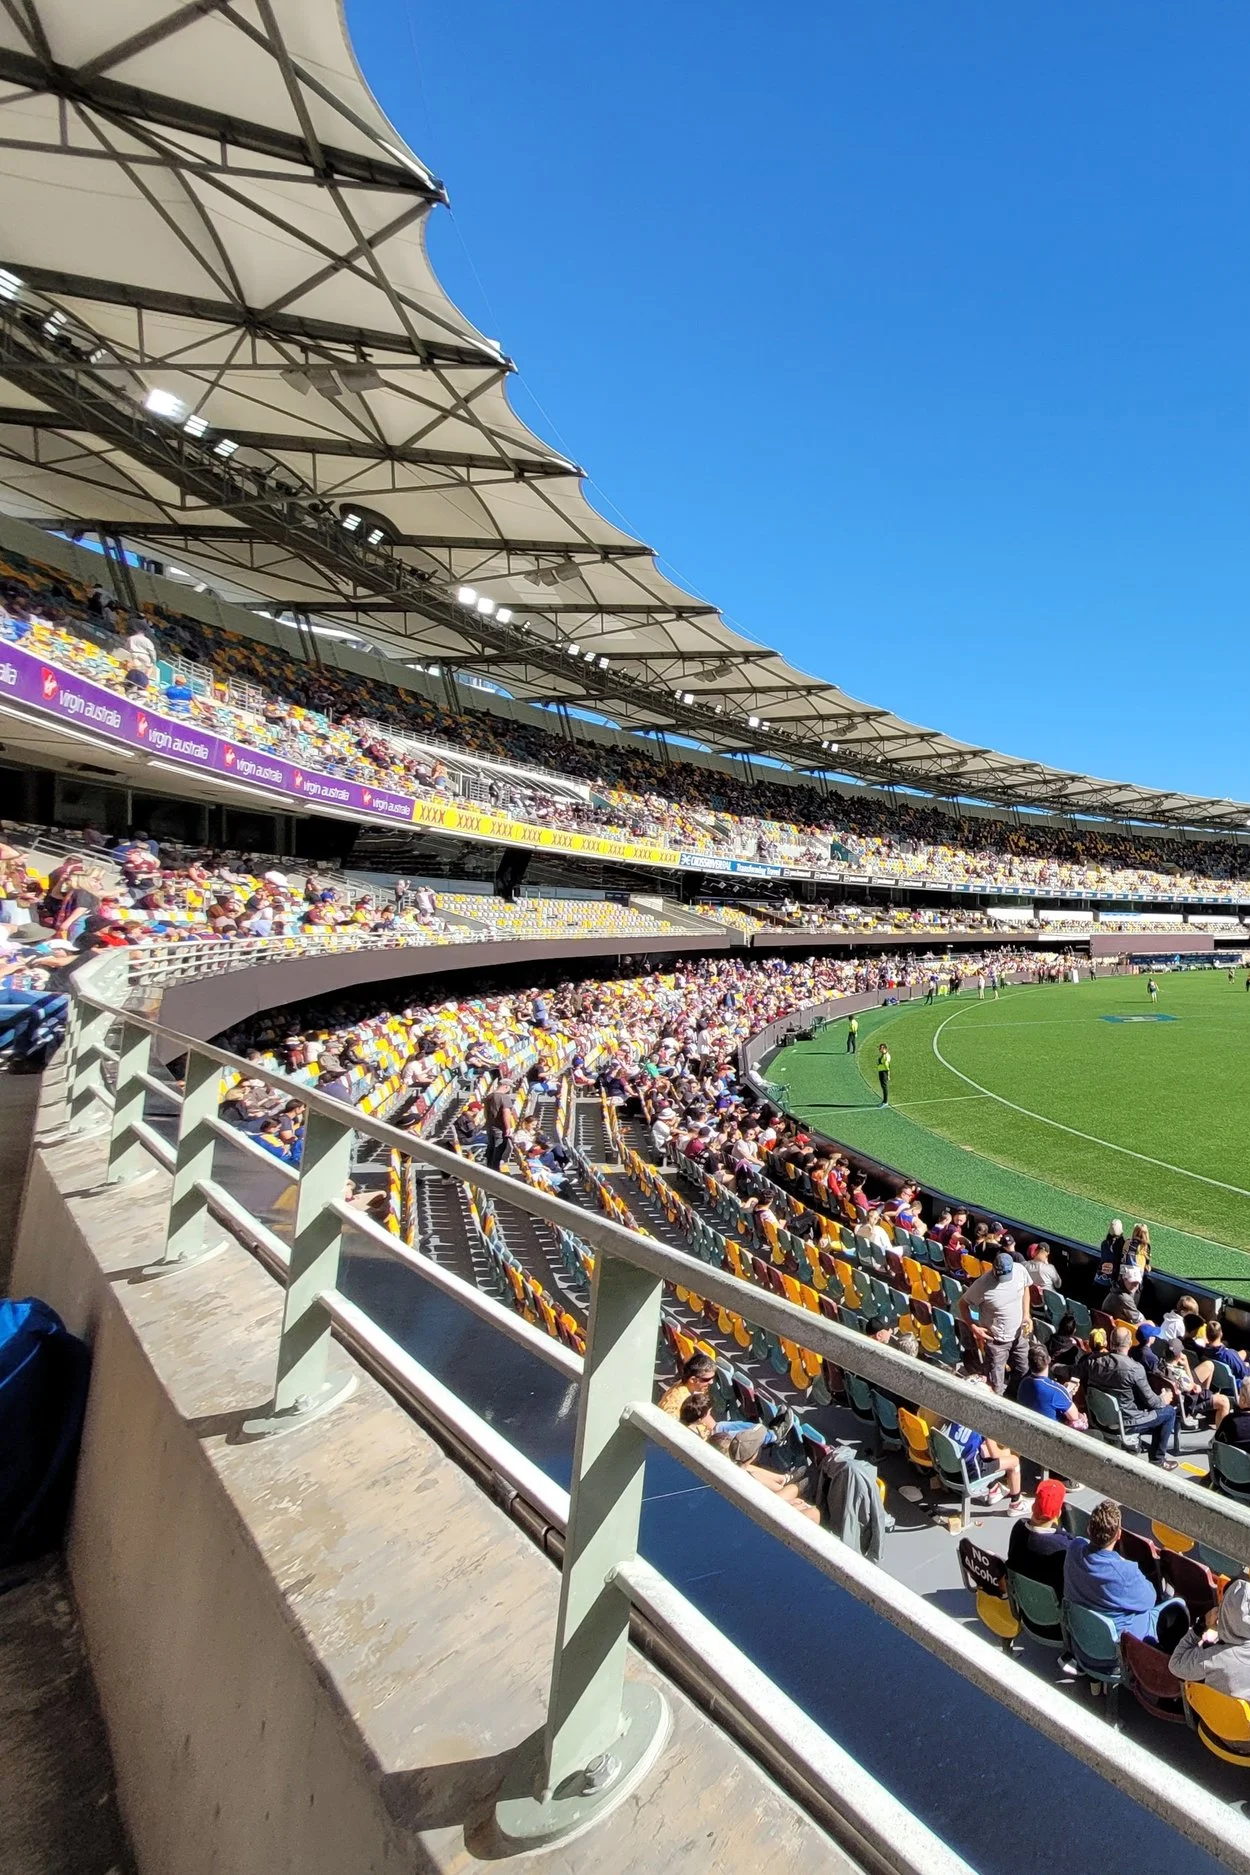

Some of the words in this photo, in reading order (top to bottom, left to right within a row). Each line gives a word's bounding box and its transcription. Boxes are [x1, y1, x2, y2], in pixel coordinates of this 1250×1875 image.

[60, 690, 84, 713] virgin
[85, 702, 121, 728] australia
[148, 728, 172, 748] virgin
[173, 738, 209, 760] australia
[237, 758, 256, 775] virgin
[256, 765, 283, 783] australia
[304, 780, 321, 795] virgin
[322, 787, 350, 800] australia
[420, 805, 445, 825] XXXX
[457, 813, 482, 831] XXXX
[490, 821, 513, 837] XXXX
[972, 1547, 990, 1566] No
